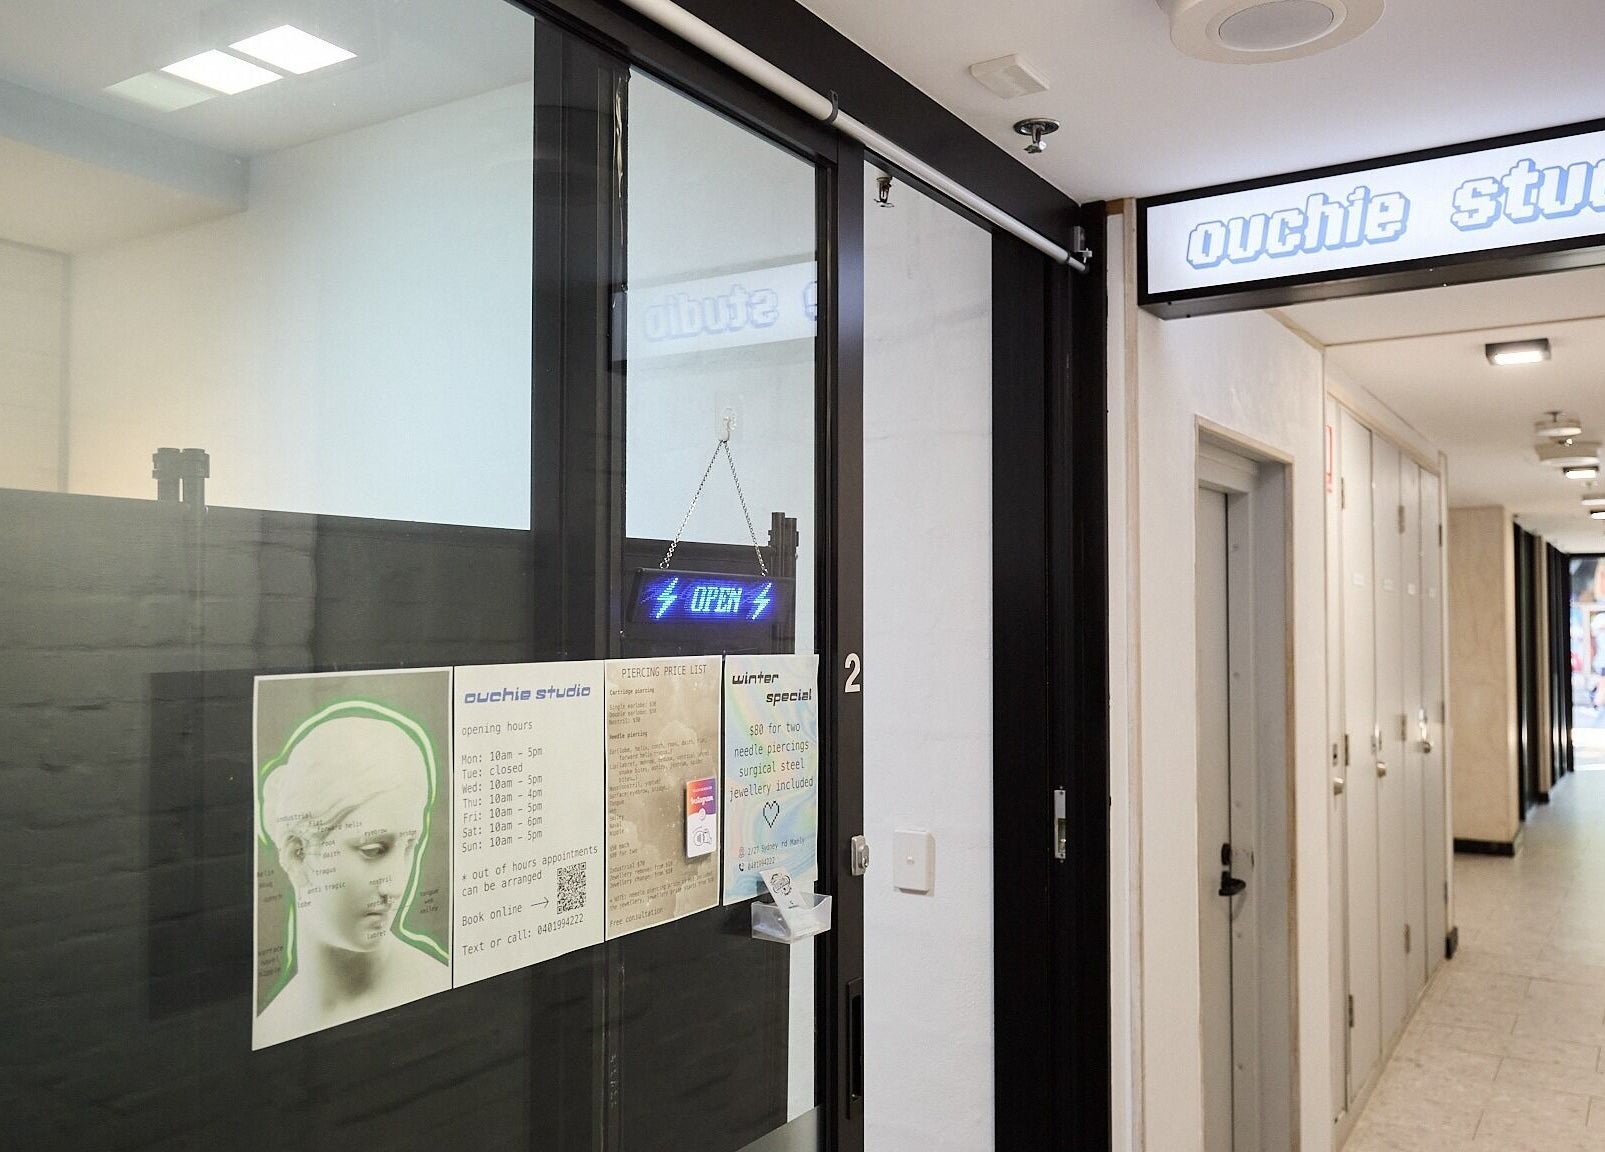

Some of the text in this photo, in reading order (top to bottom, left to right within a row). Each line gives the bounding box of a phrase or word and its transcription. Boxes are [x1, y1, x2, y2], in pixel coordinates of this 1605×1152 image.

[1186, 186, 1410, 270] ouchie
[690, 586, 743, 613] OPEN
[621, 664, 707, 679] PIERCING PRICE LIST
[732, 671, 779, 685] winter
[844, 652, 861, 693] 2
[464, 684, 591, 704] ouchie studio
[609, 687, 655, 696] Cartridge piercing
[766, 688, 812, 707] special
[461, 720, 533, 736] opening hours
[627, 729, 648, 739] piercing
[749, 722, 800, 736] $80 for two
[462, 754, 482, 765] Mon:
[490, 750, 512, 761] 10am
[528, 747, 543, 758] 5pm
[734, 740, 809, 758] needle piercings
[462, 763, 523, 779] Tue: closed
[739, 757, 805, 778] surgical steel
[462, 783, 482, 794] Wed:
[490, 779, 512, 790] 10am
[528, 775, 543, 785] 5pm
[729, 783, 771, 802] jewellery
[776, 776, 814, 792] included
[462, 798, 482, 808] Thu:
[490, 793, 512, 804] 10am
[528, 788, 543, 799] 4pm
[462, 812, 482, 824] Fri:
[490, 807, 512, 818] 10am
[528, 802, 543, 813] 5pm
[462, 826, 482, 838] Sat:
[490, 822, 512, 833] 10am
[528, 816, 543, 827] 6pm
[462, 840, 482, 853] Sun:
[490, 836, 512, 847] 10am
[528, 830, 543, 841] 5pm
[761, 843, 778, 854] Sydney
[472, 868, 489, 880] out
[495, 863, 506, 875] of
[512, 858, 537, 872] hours
[542, 845, 598, 866] appointments
[462, 870, 542, 897] can be arranged
[462, 904, 523, 927] Book online
[609, 907, 664, 928] Free consultation
[462, 913, 584, 956] Text or call: 0401994222
